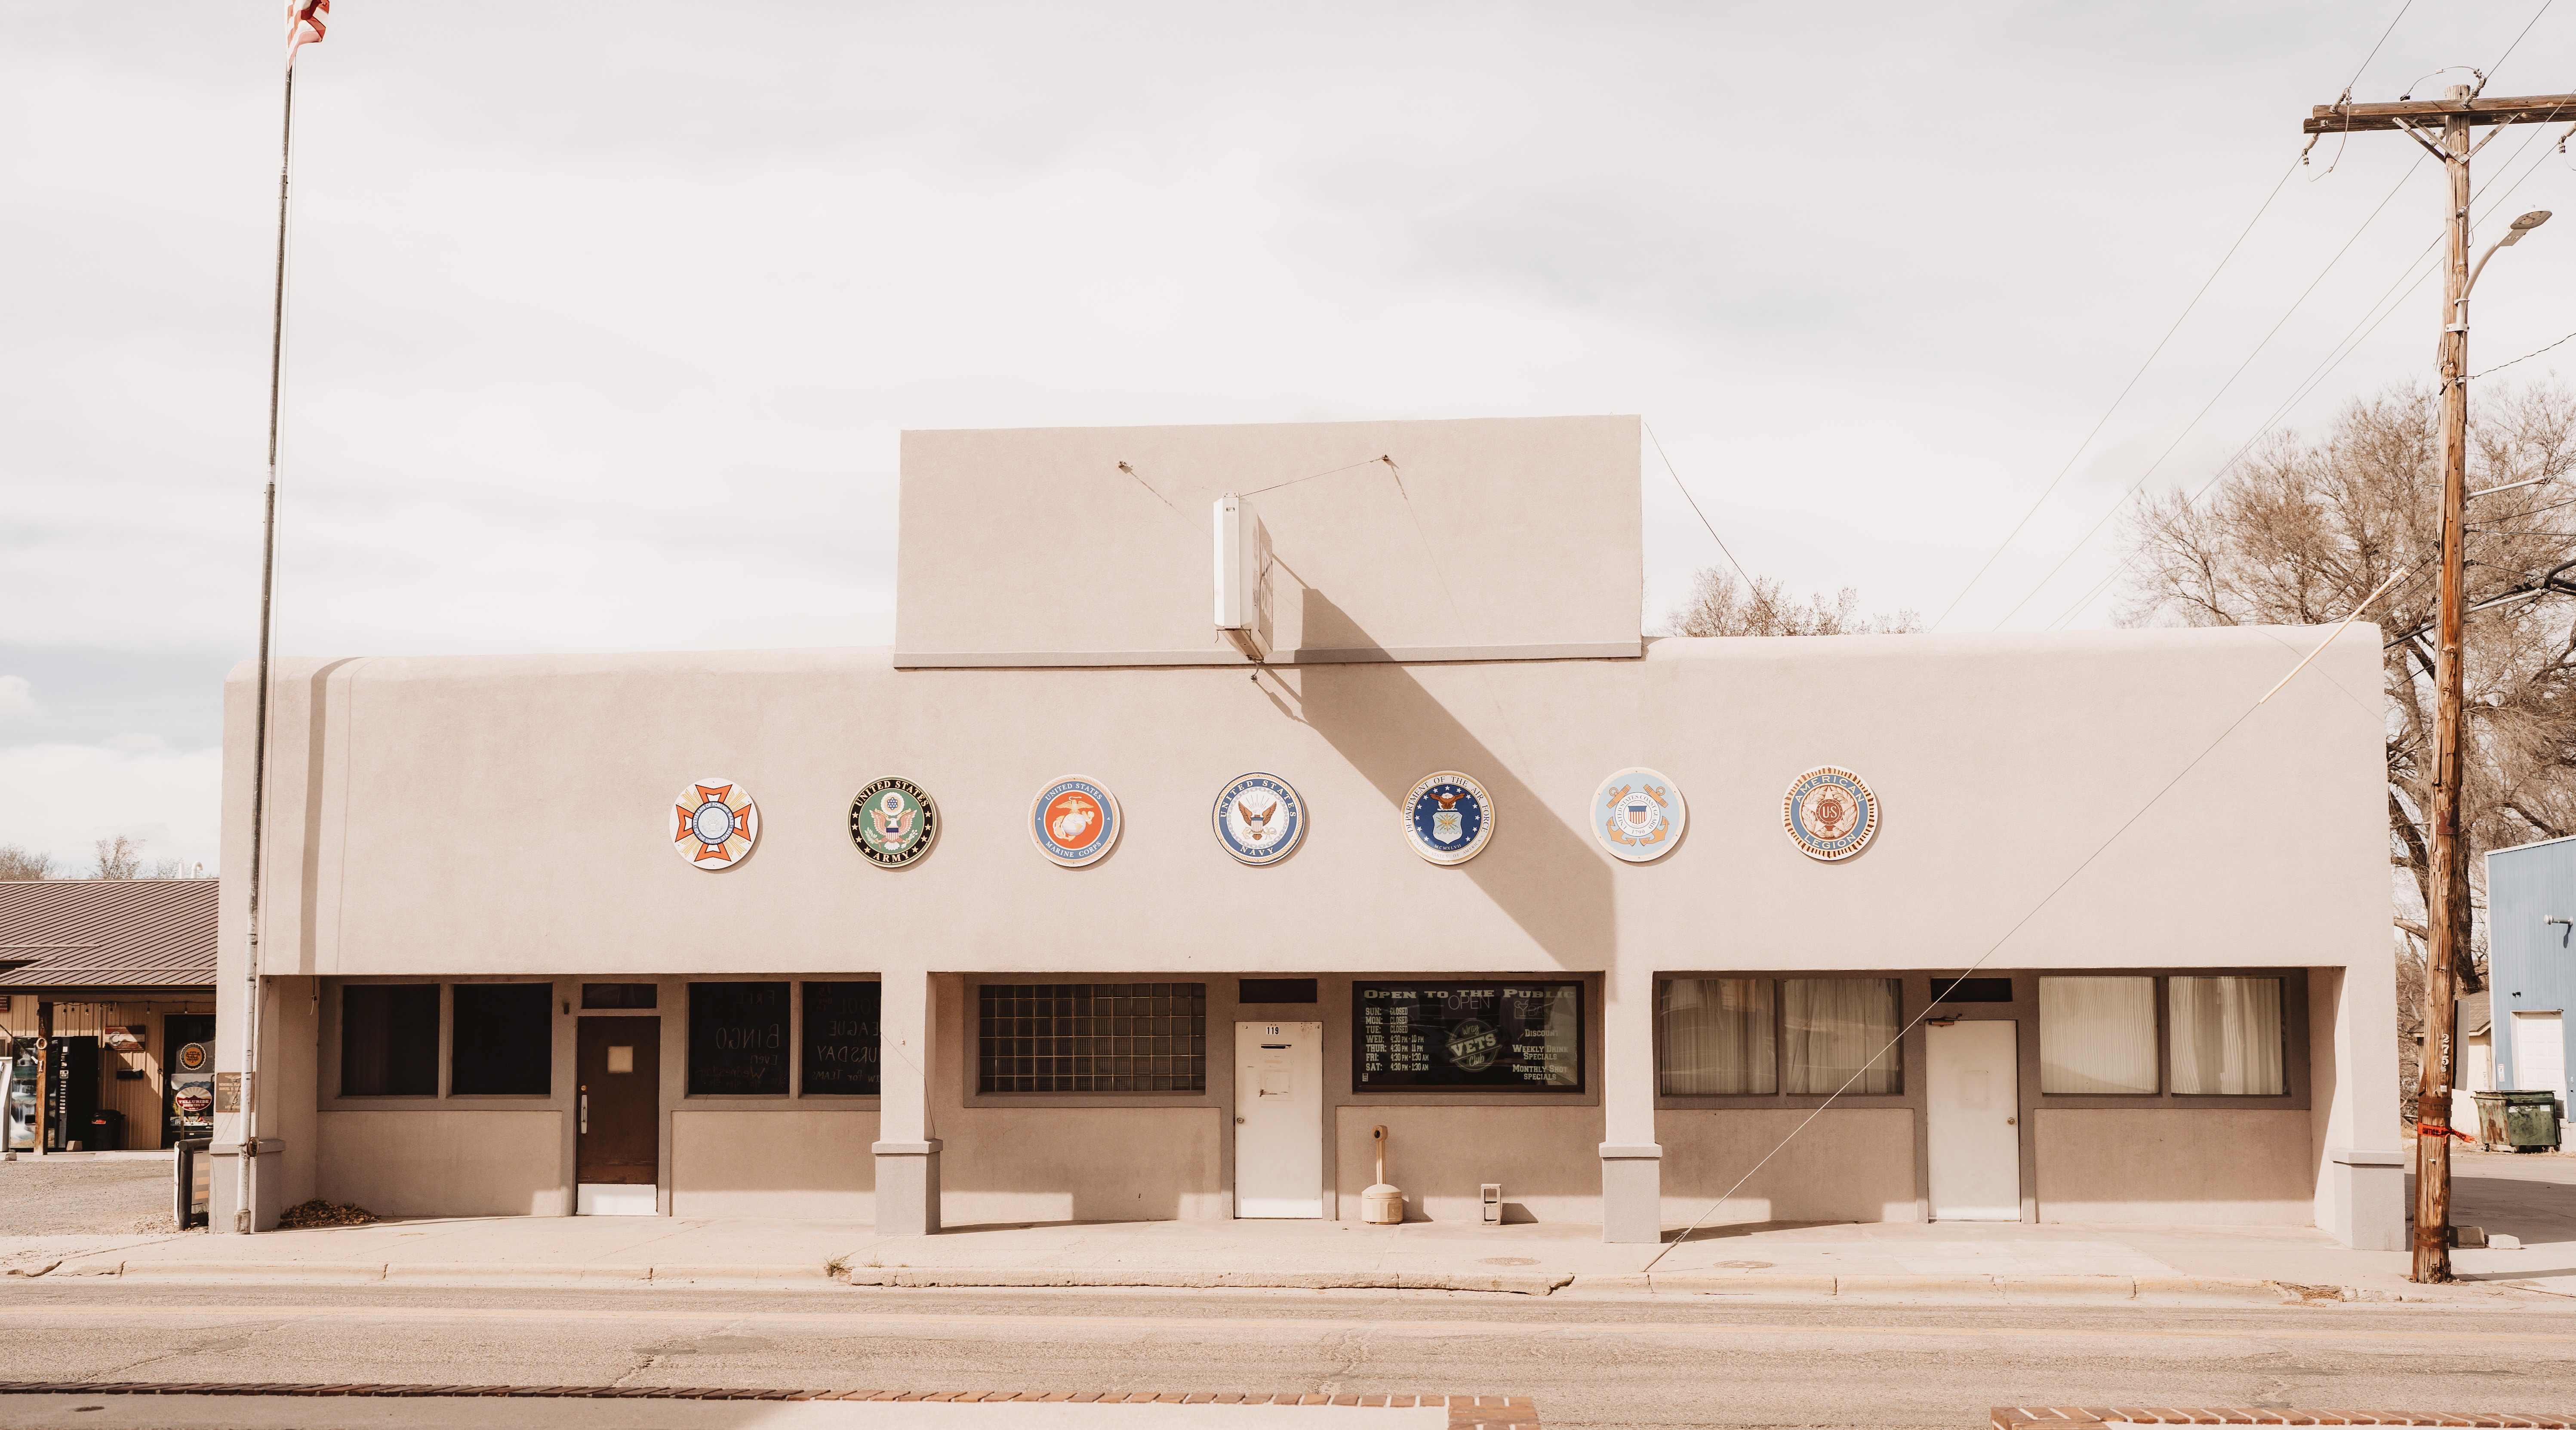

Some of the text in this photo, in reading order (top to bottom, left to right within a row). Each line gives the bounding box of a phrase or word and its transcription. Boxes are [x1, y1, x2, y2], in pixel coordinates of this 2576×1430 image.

[1261, 579, 1272, 624] CLUB
[855, 780, 929, 807] UNITED STATES
[1045, 783, 1102, 800] UNITED STATES
[1795, 776, 1865, 803] AMERICAN
[1220, 780, 1296, 817] UNITED STATES
[1405, 782, 1428, 832] DEPARTMENT
[1451, 776, 1468, 786] THE
[1471, 788, 1483, 801] AIR
[693, 806, 705, 826] VETERANS
[712, 803, 729, 813] FOREIGN
[1617, 795, 1658, 829] UNITED STATES COAST GUARD
[722, 828, 732, 841] STATES
[1804, 833, 1856, 849] LEGION
[1046, 841, 1102, 857] MARINE CORPS
[1240, 846, 1274, 856] NAVY
[1414, 839, 1428, 853] UNITED
[1463, 839, 1481, 855] AMERICA
[873, 851, 909, 862] ARMY
[1448, 995, 1490, 1010] OPEN
[1366, 1007, 1408, 1015] SUN: CLOSED
[1528, 1005, 1544, 1016] BA
[1366, 1016, 1408, 1024] MON: CLOSED
[1267, 1026, 1279, 1035] 119
[1366, 1025, 1408, 1033] TUE: CLOSED
[1462, 1025, 1480, 1035] Wray
[1366, 1035, 1385, 1043] WED:
[1390, 1035, 1400, 1043] 4:30
[1411, 1034, 1417, 1043] 10
[1451, 1033, 1496, 1056] VETS
[1366, 1044, 1387, 1052] THUR:
[1390, 1044, 1401, 1052] 4:30
[1411, 1044, 1416, 1052] 11
[1366, 1053, 1379, 1061] FRI:
[1390, 1053, 1401, 1061] 4:30
[1412, 1053, 1421, 1061] 1:30
[1469, 1053, 1484, 1066] Club
[1366, 1063, 1382, 1071] SAT:
[1390, 1063, 1401, 1071] 4:30
[1412, 1063, 1421, 1071] 1:30
